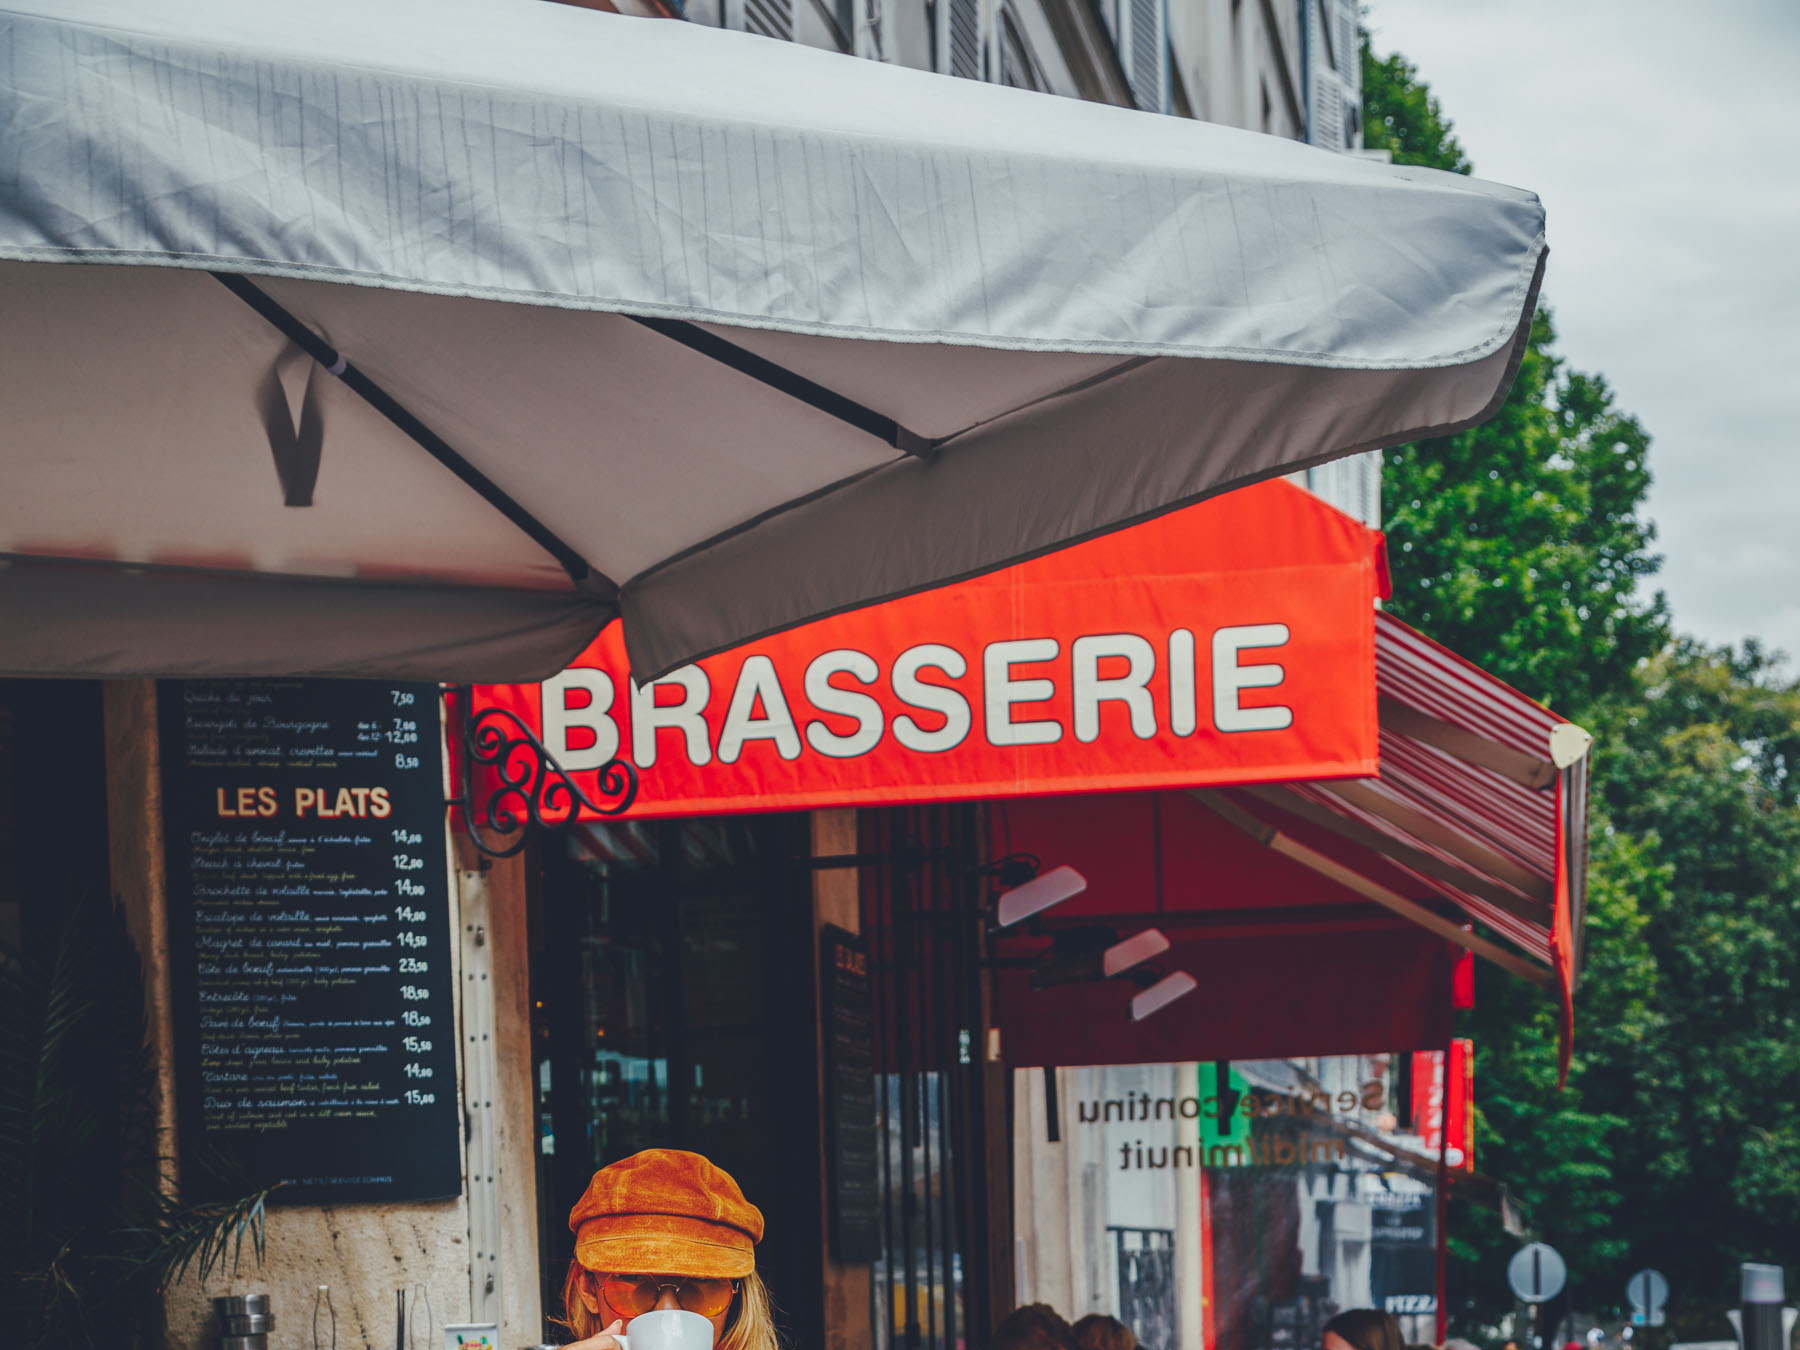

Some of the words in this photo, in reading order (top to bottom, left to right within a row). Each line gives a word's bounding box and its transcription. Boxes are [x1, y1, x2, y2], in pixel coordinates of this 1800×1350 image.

[390, 690, 415, 706] 7,50
[540, 622, 1293, 772] BRASSERIE
[393, 718, 417, 731] 7,00
[385, 731, 418, 744] 12,00
[395, 754, 420, 770] 8,50
[217, 786, 278, 818] LES
[295, 786, 392, 818] PLATS
[391, 829, 423, 845] 14,00
[392, 855, 424, 870] 12,00
[394, 879, 425, 896] 14,00
[394, 906, 426, 922] 14,00
[397, 931, 428, 948] 14,50
[398, 958, 429, 973] 23,50
[400, 985, 430, 1001] 18,50
[401, 1010, 431, 1027] 18,50
[402, 1037, 433, 1053] 15,50
[403, 1063, 434, 1079] 14,00
[257, 1097, 308, 1109] saumon
[404, 1090, 436, 1106] 15,00
